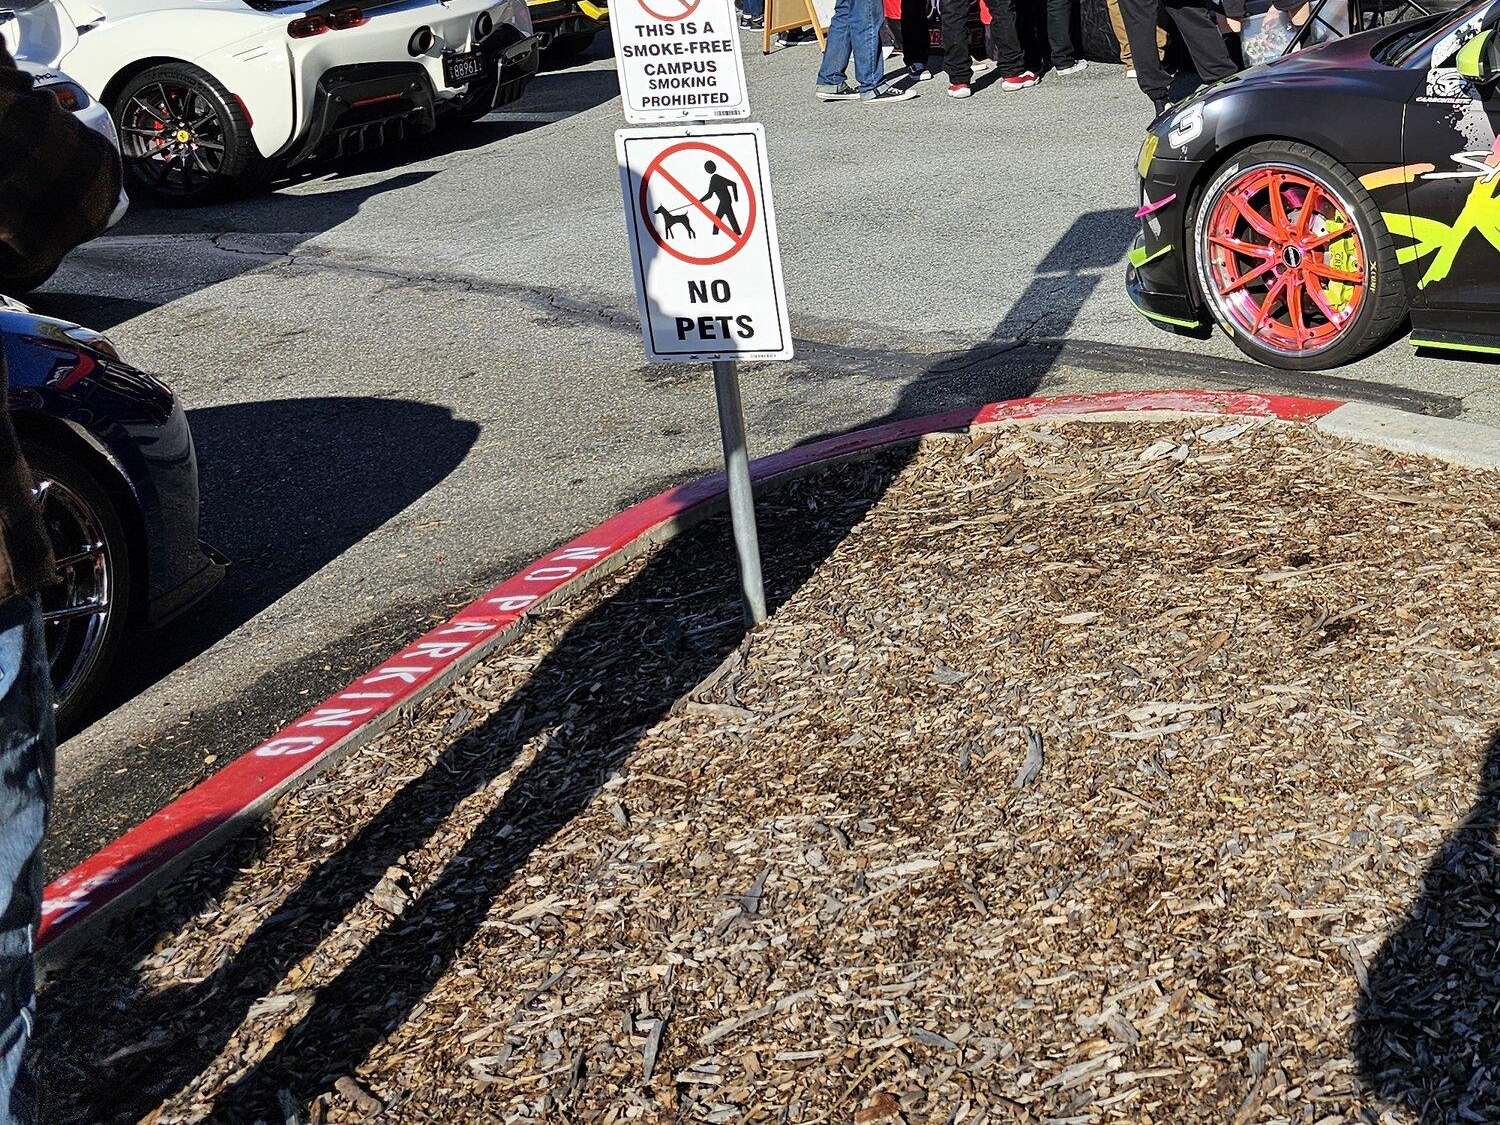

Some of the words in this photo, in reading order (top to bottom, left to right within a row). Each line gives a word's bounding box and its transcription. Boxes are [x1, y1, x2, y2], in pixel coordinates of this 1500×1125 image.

[635, 23, 675, 37] THIS
[680, 22, 697, 35] IS
[703, 21, 715, 34] A
[622, 40, 733, 58] SMOKE-FREE
[644, 60, 717, 76] CAMPUS
[648, 76, 717, 90] SMOKING
[642, 92, 729, 107] PROHIBITED
[1168, 100, 1205, 150] 3
[687, 279, 731, 304] NO
[675, 315, 755, 341] PETS
[524, 546, 612, 581] NO
[255, 594, 539, 758] PARKING
